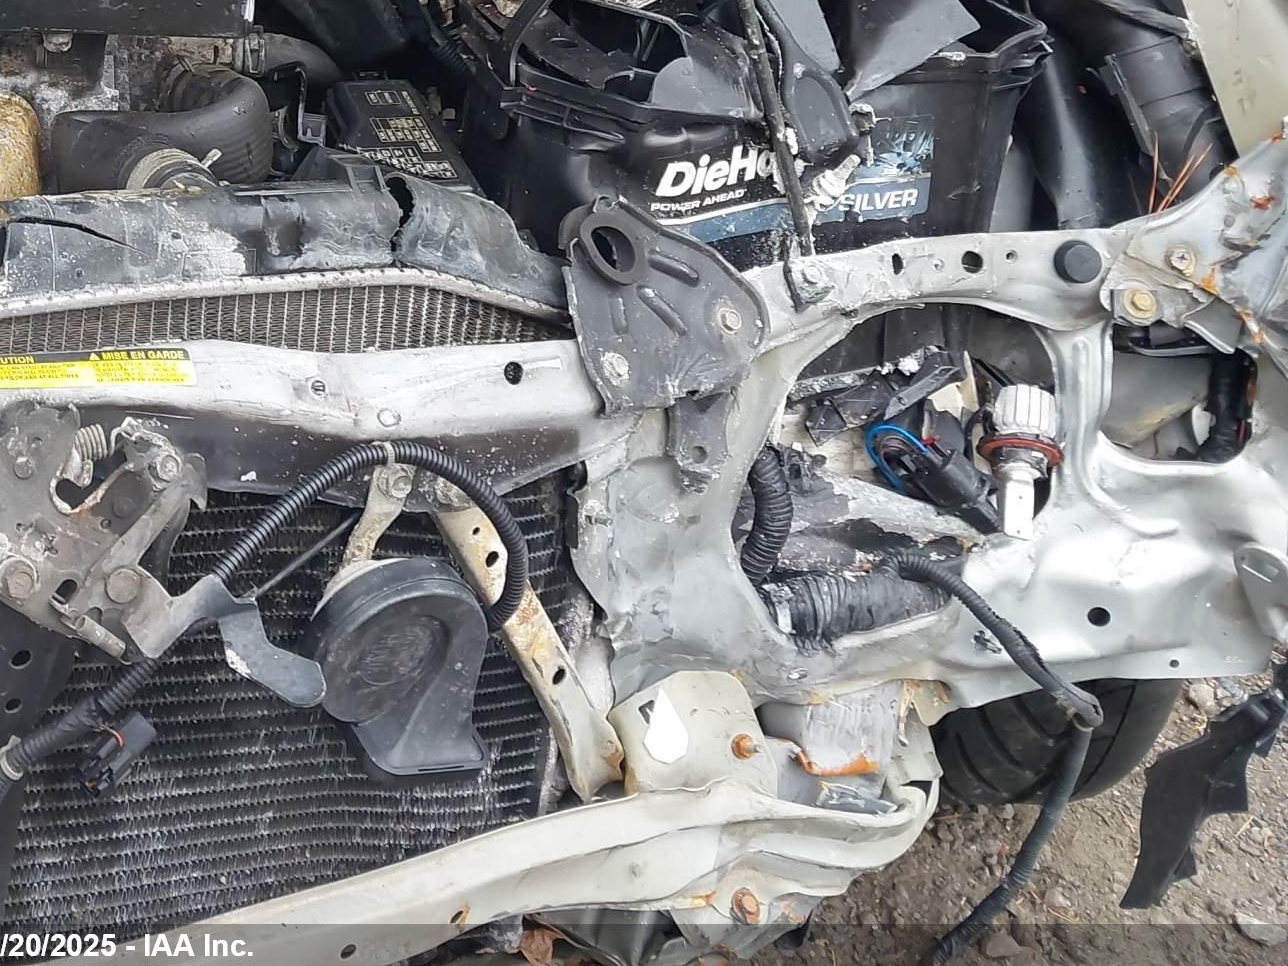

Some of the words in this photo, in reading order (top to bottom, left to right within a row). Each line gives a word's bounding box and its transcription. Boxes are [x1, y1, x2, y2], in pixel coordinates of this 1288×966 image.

[649, 199, 700, 213] POWER
[702, 189, 747, 205] AHEAD
[839, 188, 918, 212] SILVER
[102, 351, 128, 360] MISE
[130, 351, 146, 360] EN
[147, 350, 185, 360] GARDE
